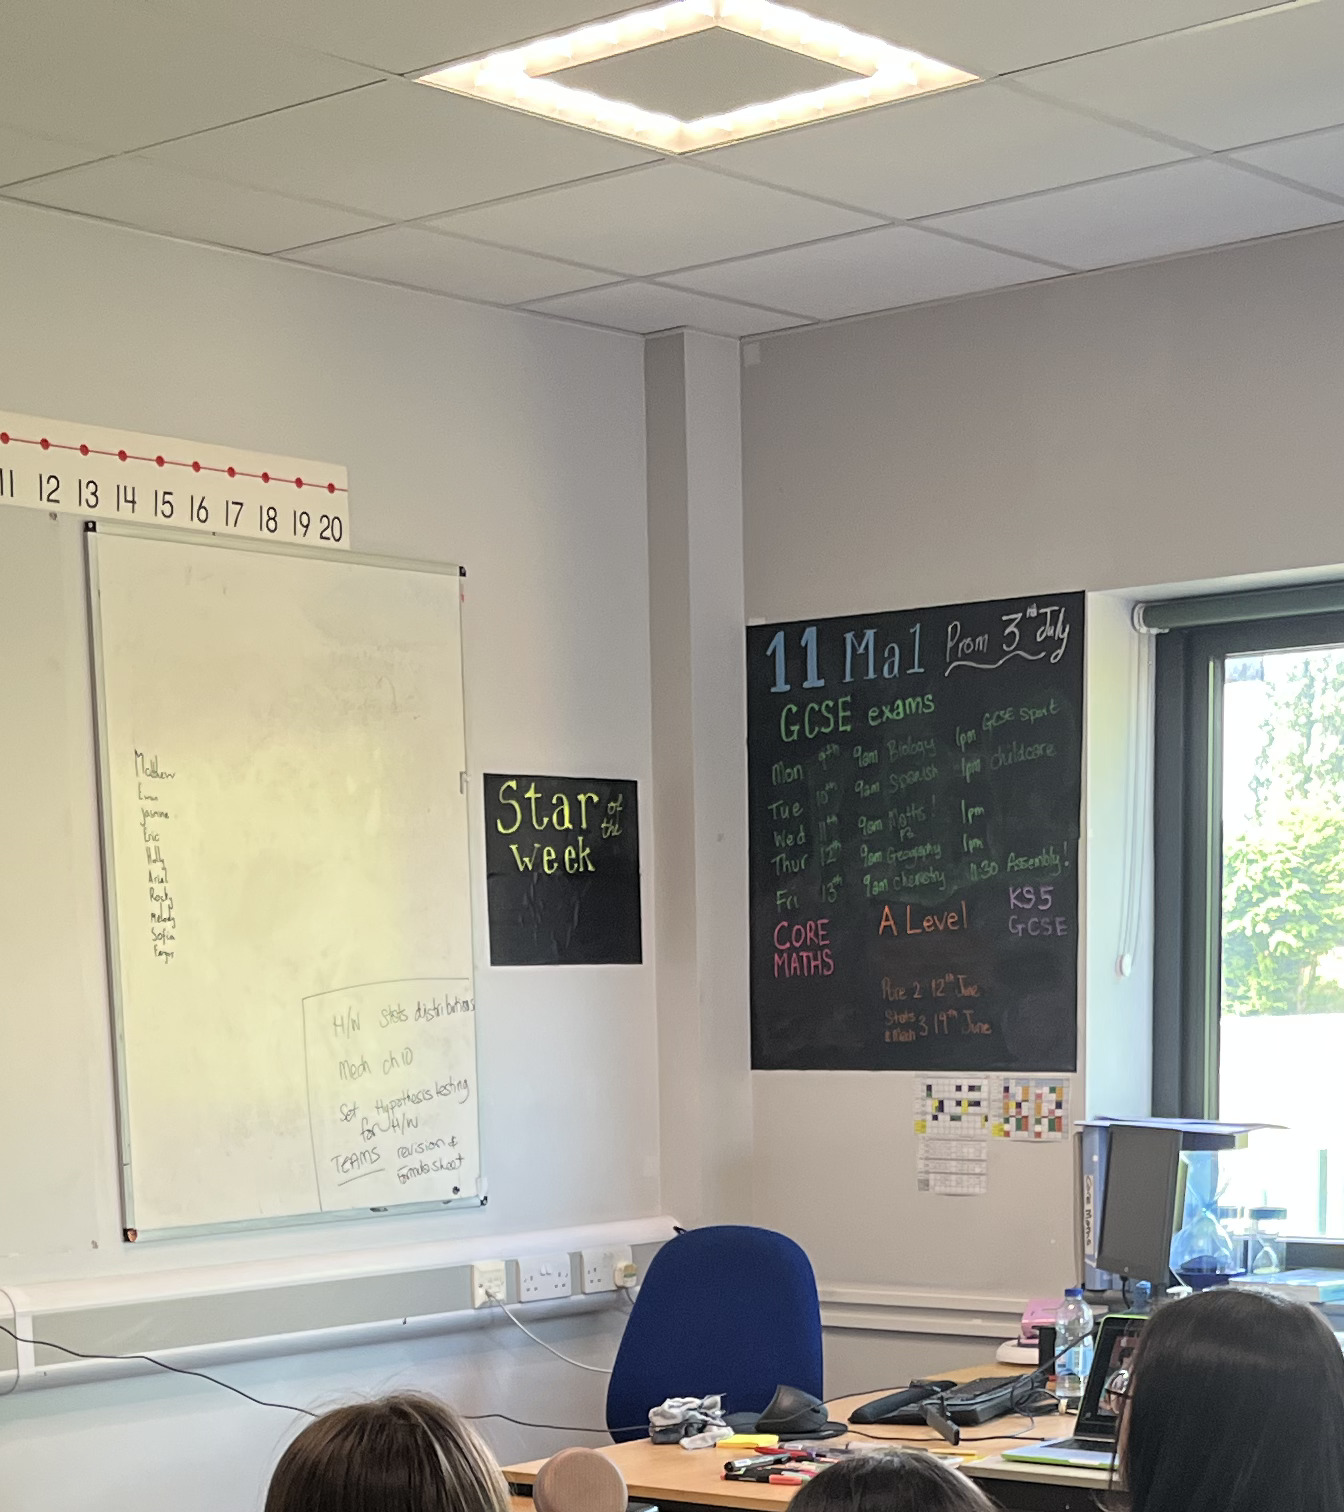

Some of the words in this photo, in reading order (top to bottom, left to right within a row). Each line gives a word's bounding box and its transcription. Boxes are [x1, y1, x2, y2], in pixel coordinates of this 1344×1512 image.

[0, 467, 14, 498] 11
[38, 473, 61, 504] 12
[78, 478, 99, 509] 13
[116, 484, 137, 514] 14
[154, 489, 174, 519] 15
[190, 494, 209, 524] 16
[225, 499, 244, 528] 17
[259, 504, 278, 534] 18
[293, 509, 311, 538] 19
[319, 514, 343, 543] 20
[946, 620, 989, 663] Prom
[1036, 607, 1070, 664] July
[766, 626, 825, 693] 11
[780, 695, 852, 743] GCSE
[868, 693, 935, 727] exams
[771, 761, 805, 786] Mon
[853, 745, 879, 768] 9am
[982, 707, 1016, 732] GCSE
[496, 779, 600, 835] Star
[607, 793, 624, 815] of
[768, 800, 804, 820] Tue
[856, 780, 880, 798] 9am
[774, 824, 806, 848] Wed
[770, 852, 808, 876] Thur
[776, 890, 799, 913] Fri
[863, 873, 888, 897] 9am
[773, 918, 831, 950] CORE
[878, 904, 899, 937] A
[906, 900, 968, 935] Level
[1009, 914, 1068, 937] GCSE
[773, 948, 835, 979] MATHS
[913, 981, 923, 999] 2
